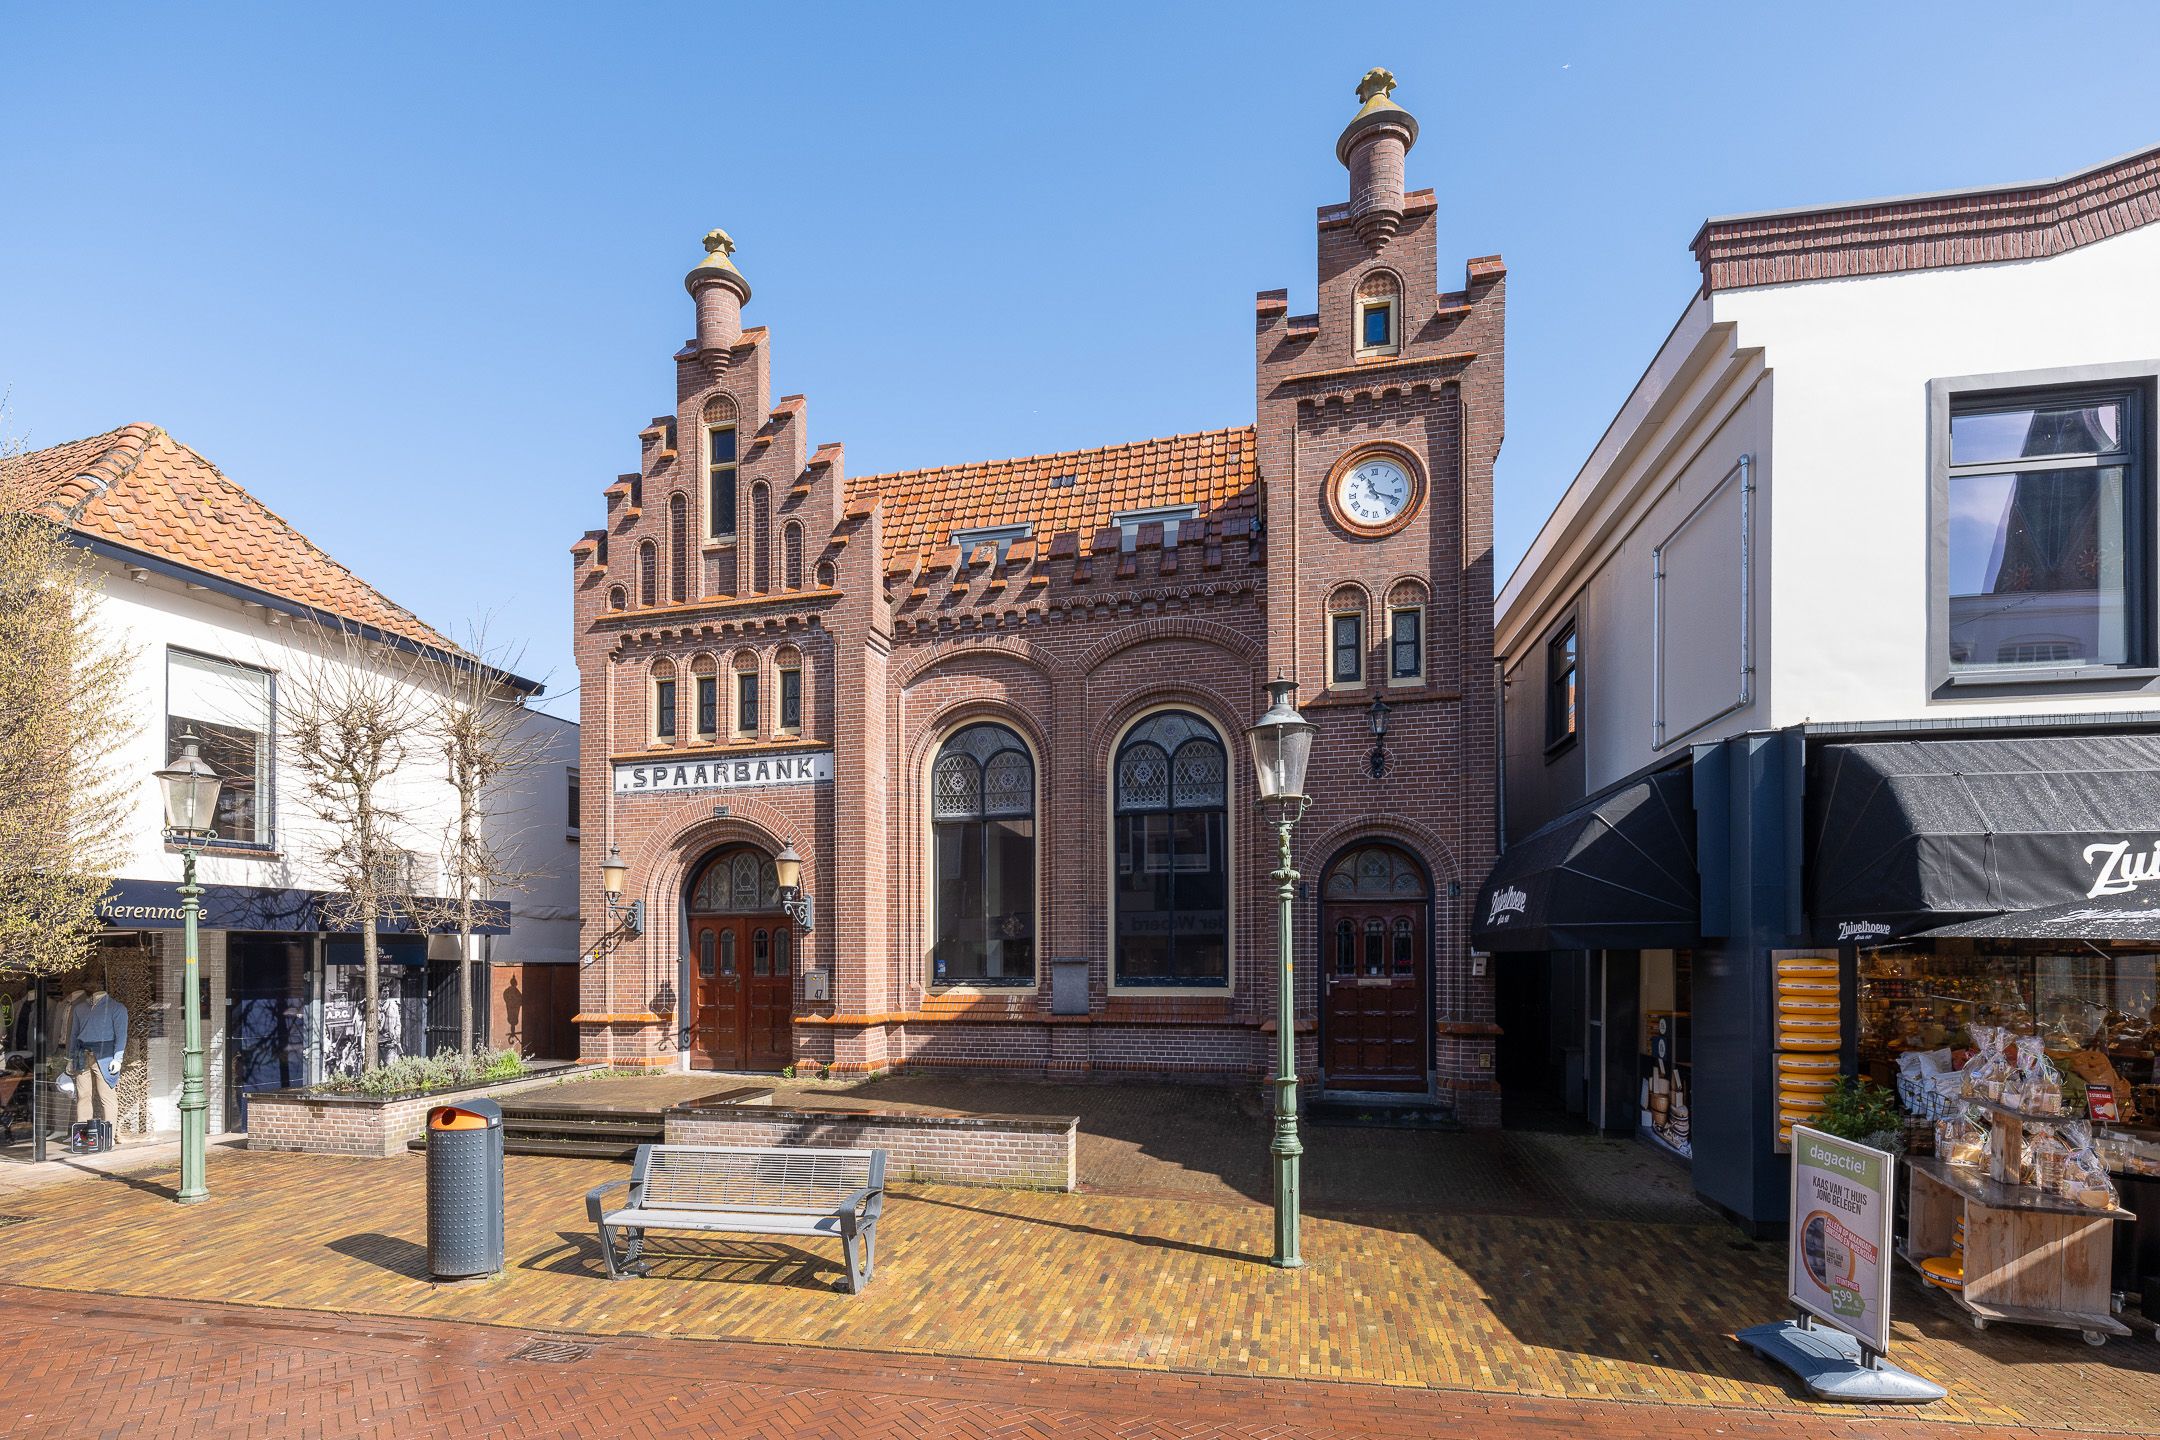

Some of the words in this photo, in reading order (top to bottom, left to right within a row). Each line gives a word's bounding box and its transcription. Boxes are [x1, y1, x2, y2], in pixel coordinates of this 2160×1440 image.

[633, 757, 814, 789] SPAARBANK
[101, 901, 208, 920] herenmoe
[1838, 921, 1891, 940] Zuivelhoeve
[815, 990, 823, 999] 47
[1810, 1145, 1866, 1175] dagactie!
[1812, 1176, 1829, 1191] KAAS
[1830, 1182, 1842, 1196] VAN
[1851, 1190, 1867, 1206] HUIS
[1816, 1189, 1831, 1203] JONG
[1832, 1195, 1861, 1215] BELEGEN
